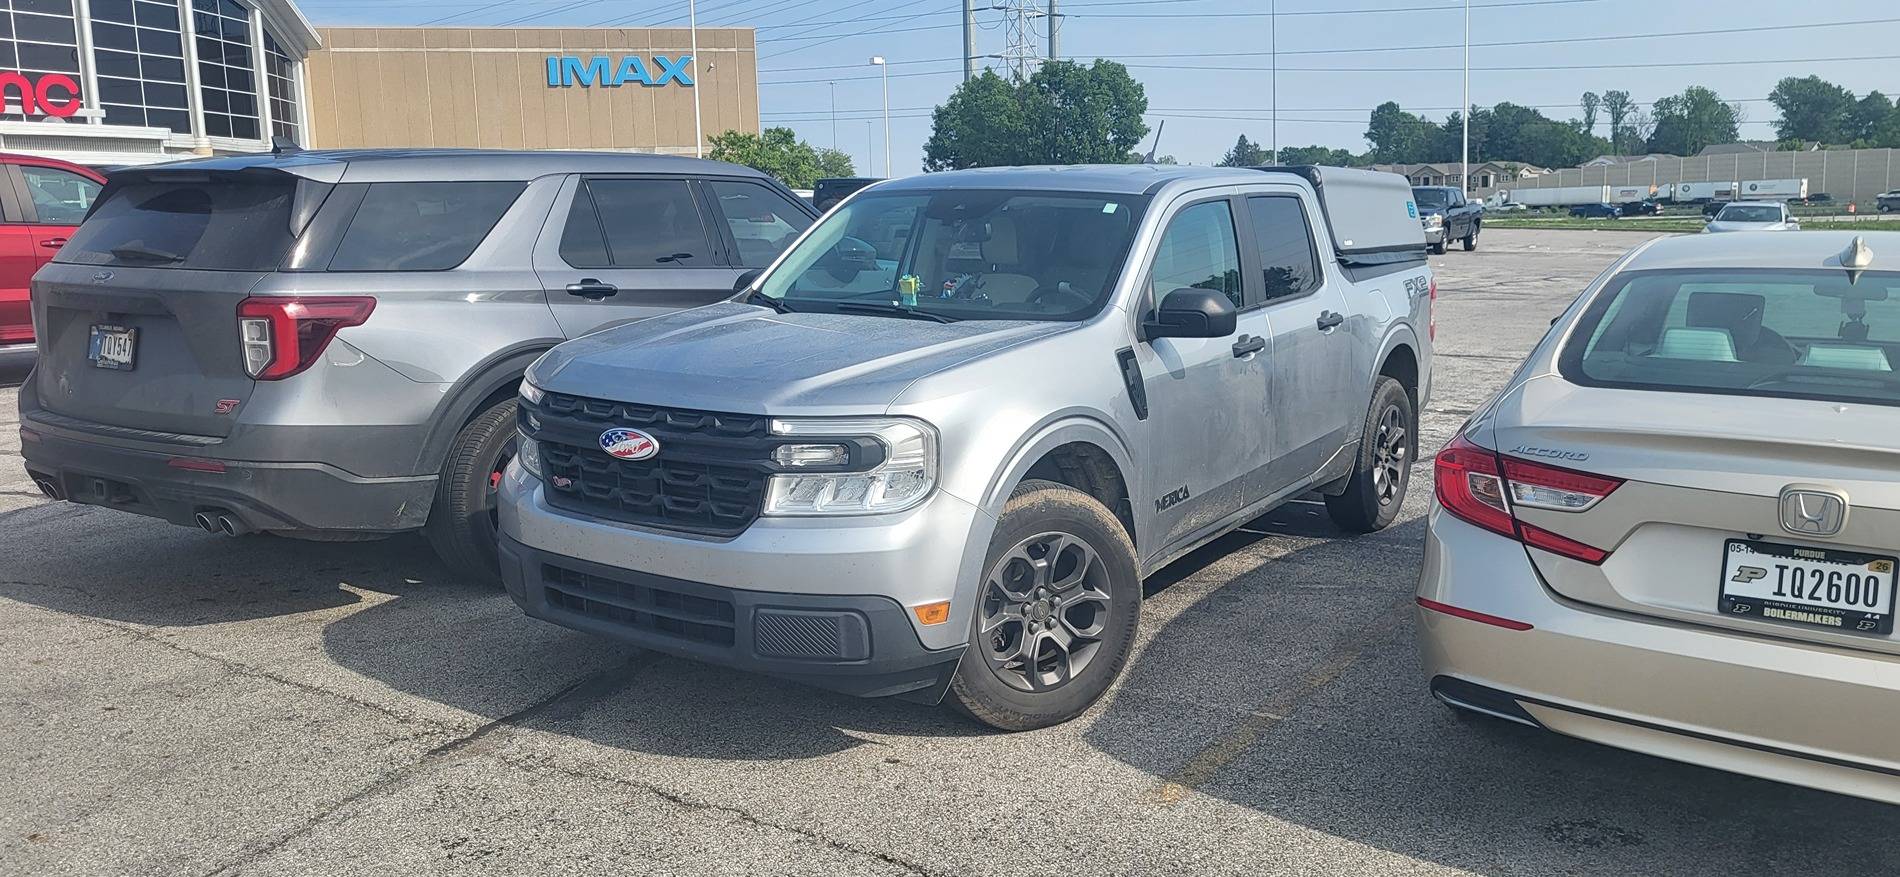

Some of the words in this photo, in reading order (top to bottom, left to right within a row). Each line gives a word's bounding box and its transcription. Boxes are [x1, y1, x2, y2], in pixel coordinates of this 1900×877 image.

[546, 55, 695, 87] IMAX
[1403, 275, 1429, 299] FX2
[214, 399, 241, 414] ST
[1508, 444, 1590, 462] ACCORD
[1793, 548, 1826, 560] PURDUE
[1875, 561, 1889, 571] 26
[1772, 564, 1880, 608] IQ2600
[1763, 607, 1843, 627] BOILERMAKERS
